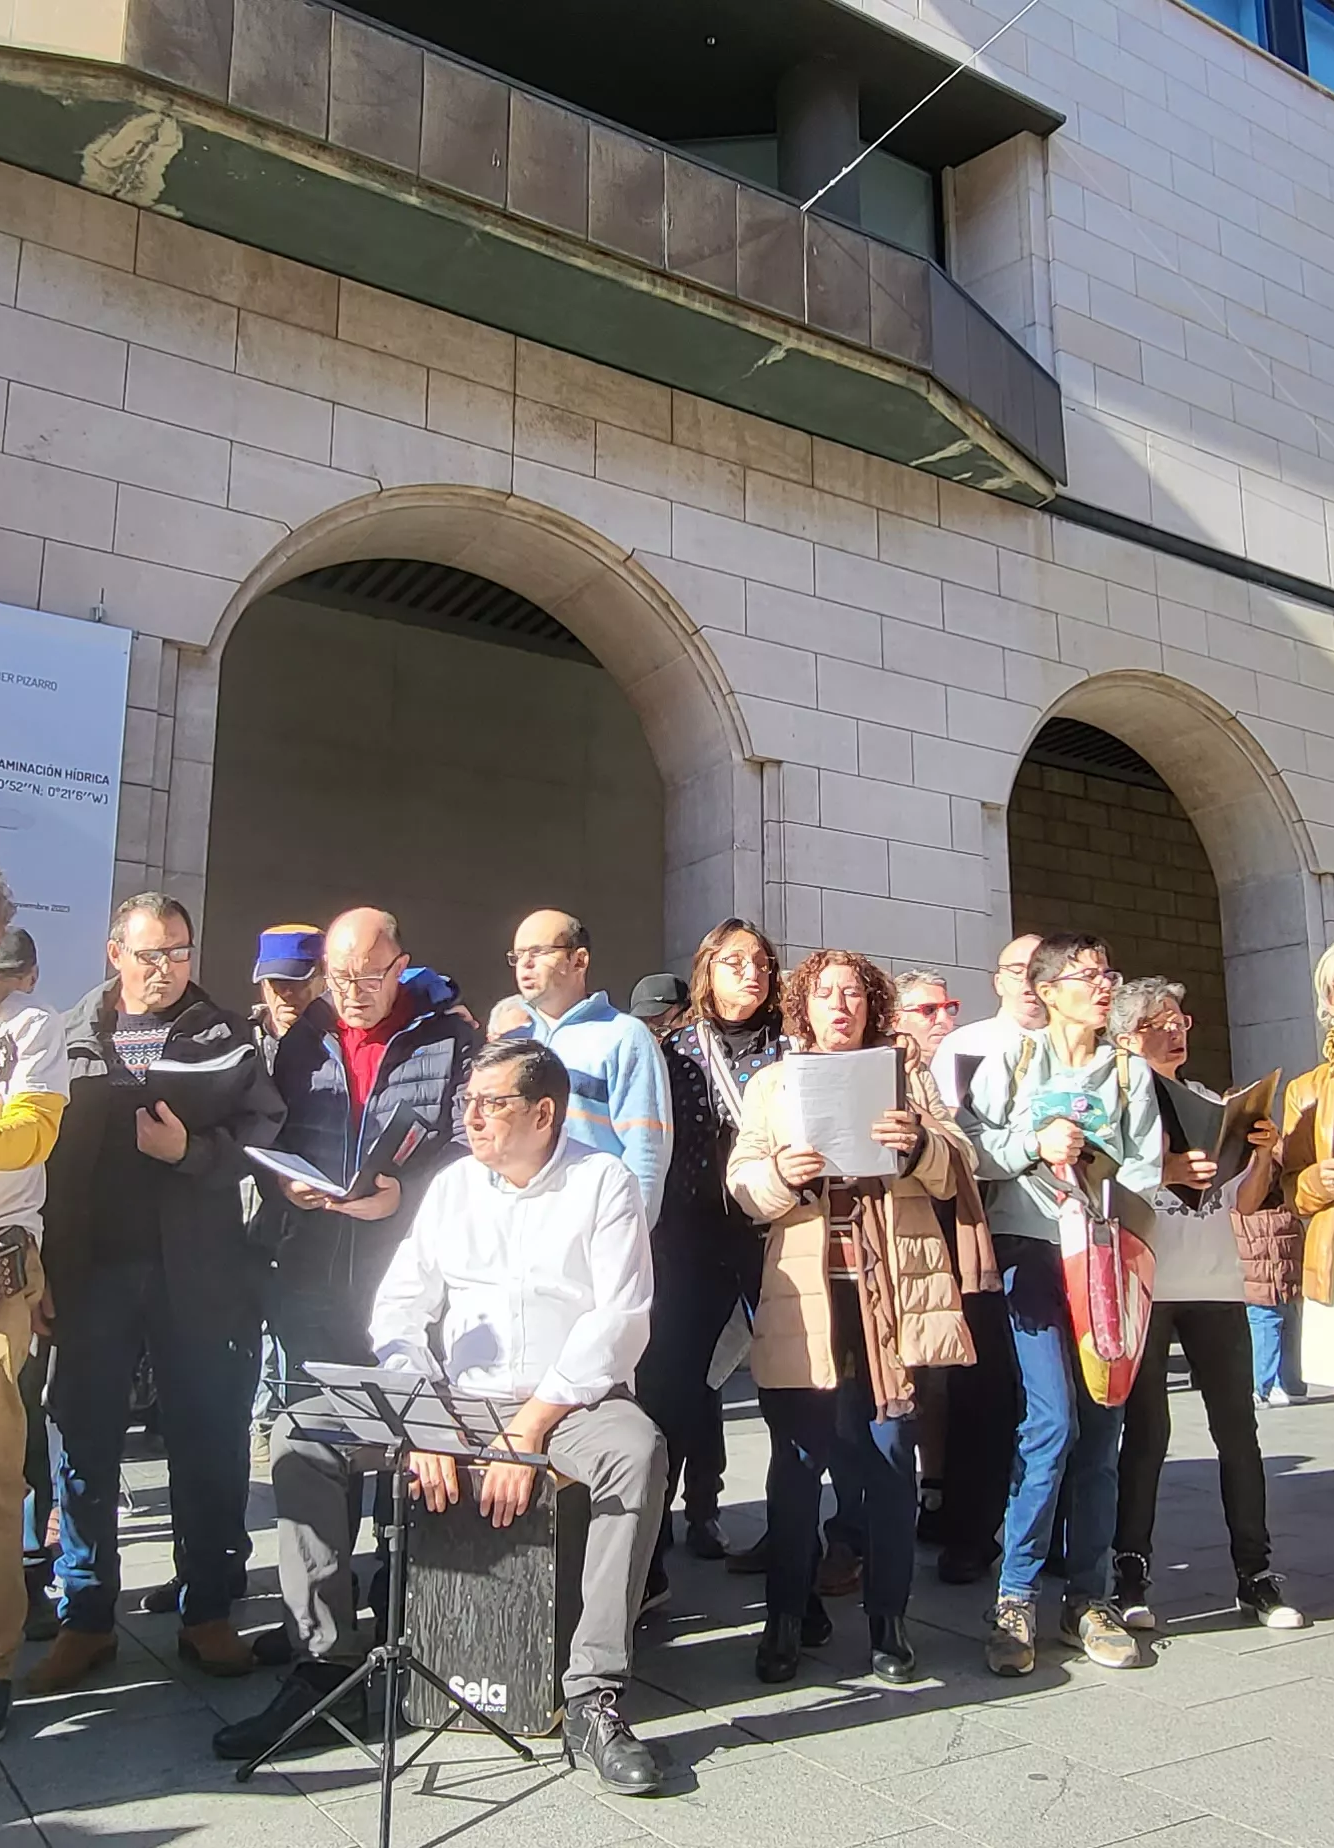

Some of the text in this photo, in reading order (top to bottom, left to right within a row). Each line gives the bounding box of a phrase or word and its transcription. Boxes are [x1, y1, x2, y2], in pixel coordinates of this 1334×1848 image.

[16, 674, 58, 692] PIZARRO
[65, 767, 110, 786] HÍDRICA
[448, 1675, 507, 1706] Sela
